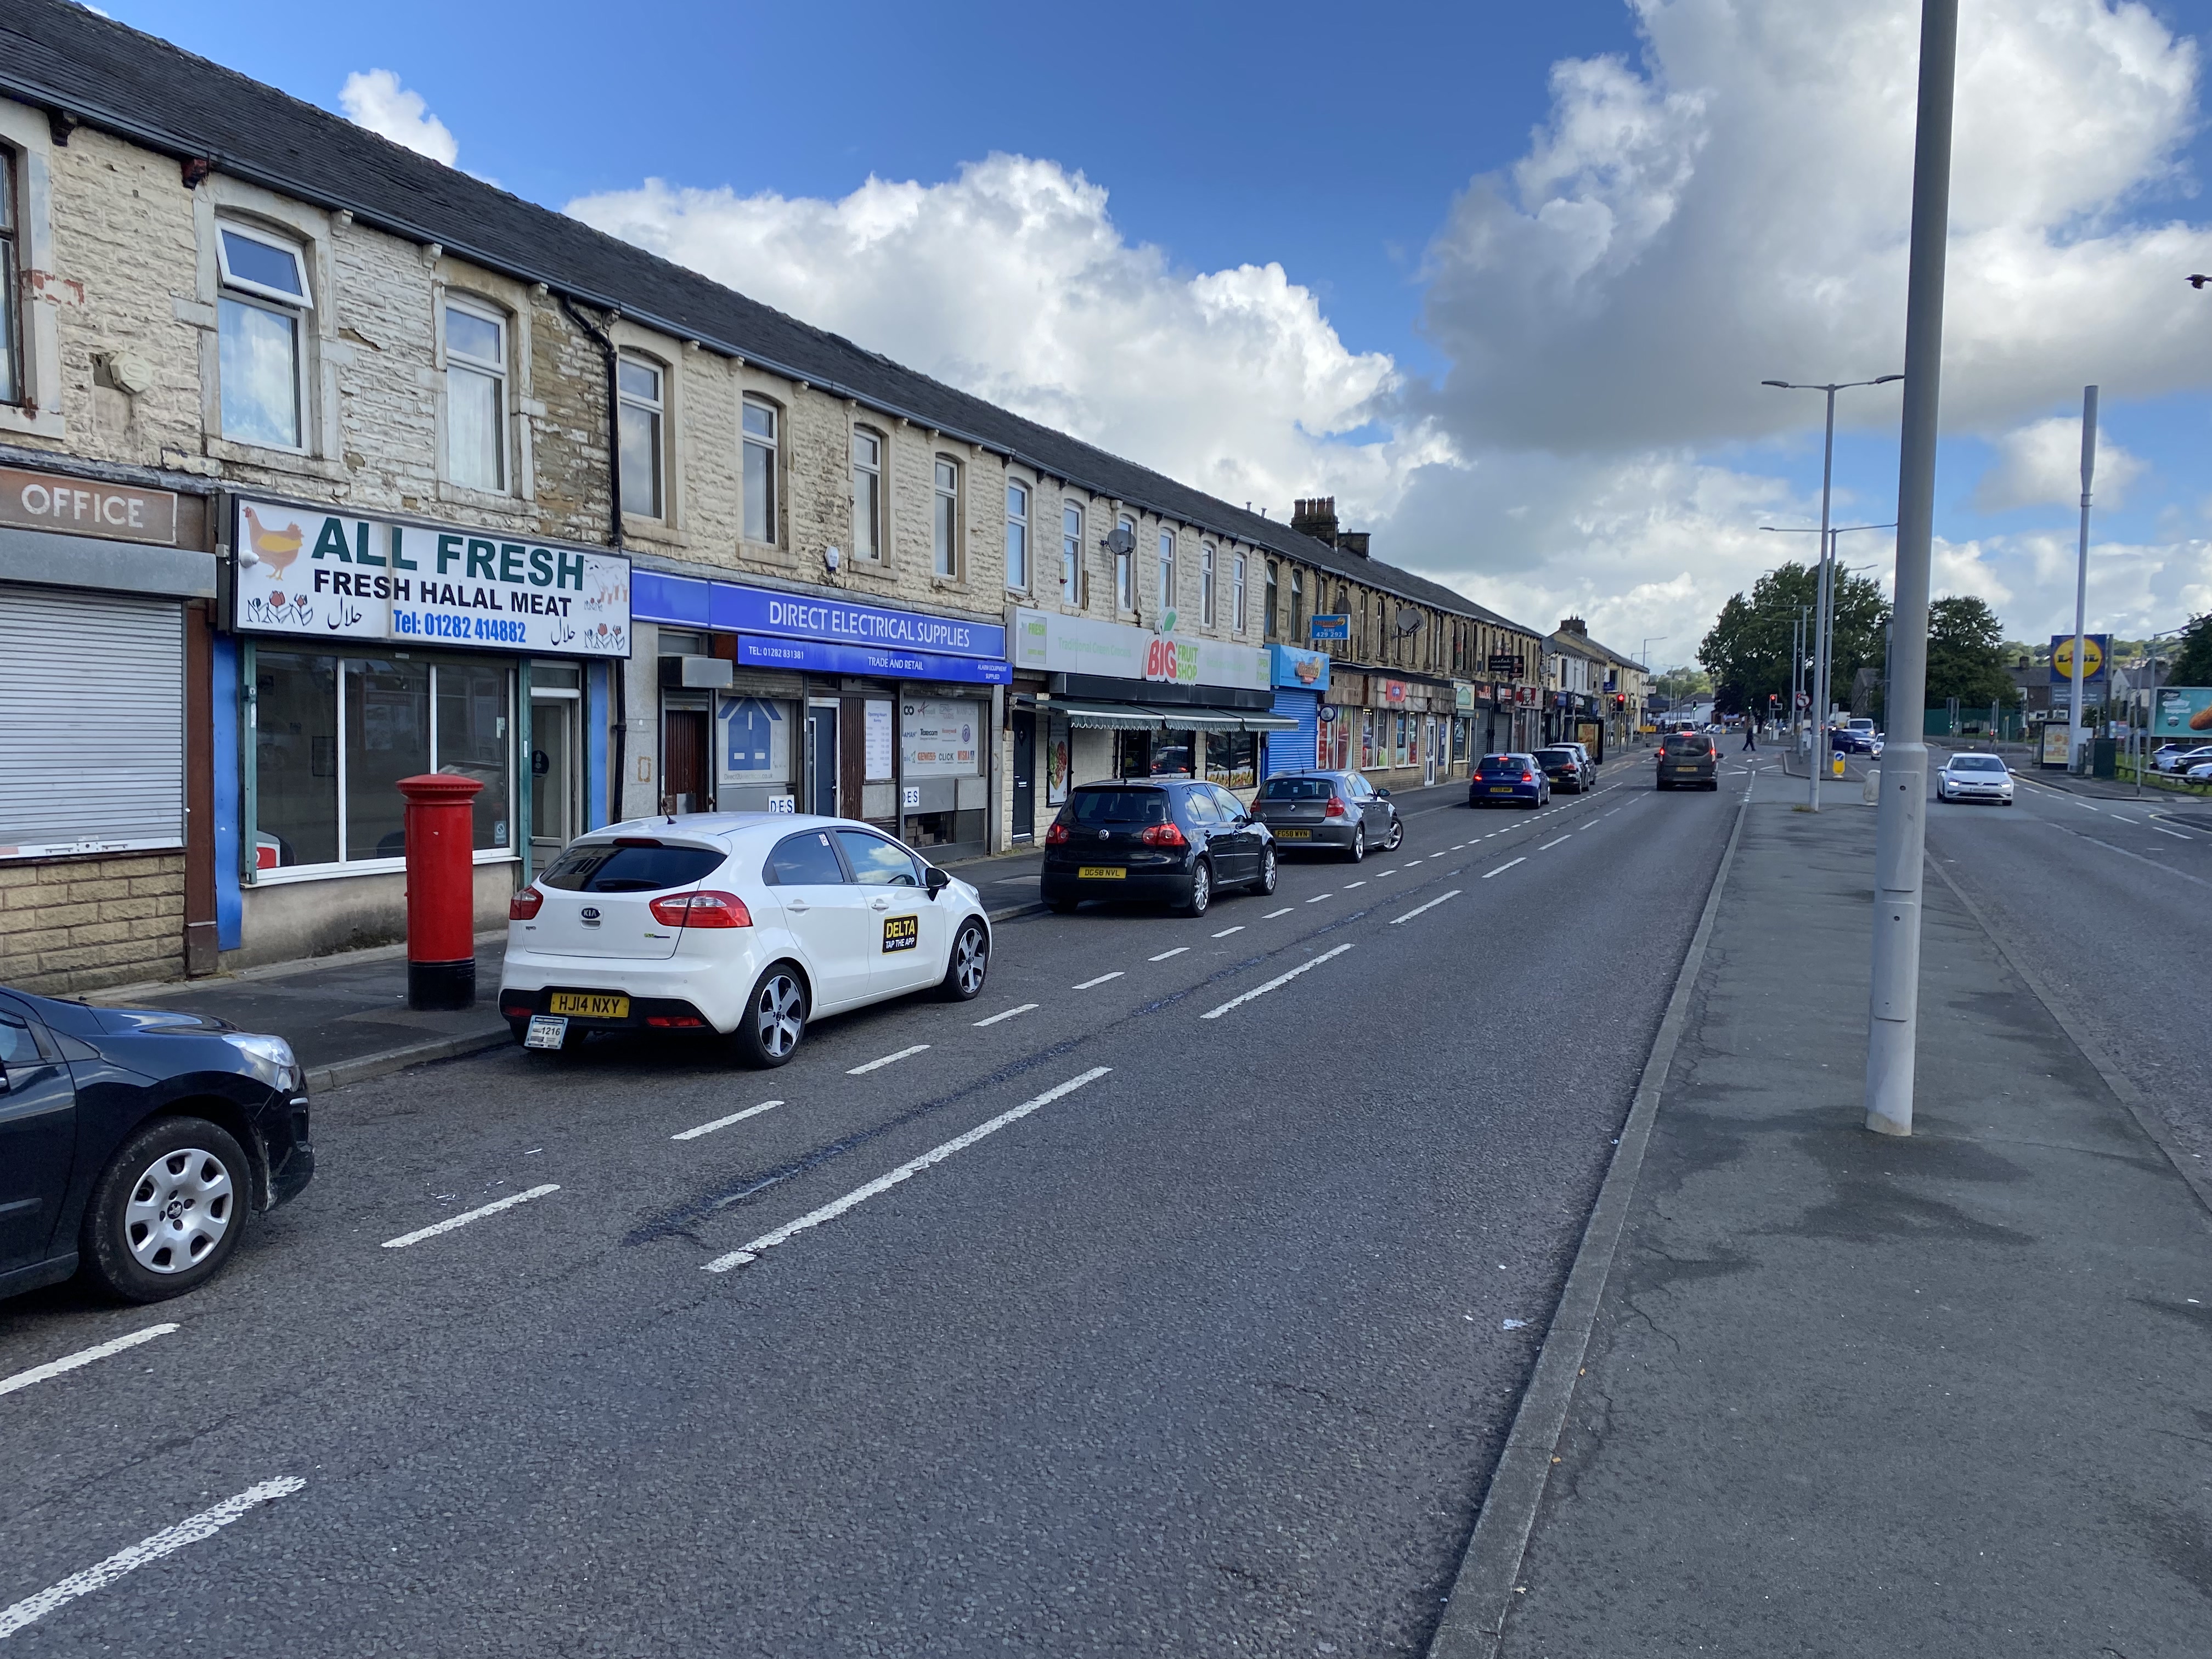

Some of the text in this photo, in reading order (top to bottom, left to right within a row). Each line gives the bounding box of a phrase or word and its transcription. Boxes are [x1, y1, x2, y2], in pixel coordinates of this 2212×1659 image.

[21, 484, 144, 528] OFFICE
[311, 516, 585, 591] ALL FRESH
[314, 569, 572, 617] FRESH HALAL MEAT
[328, 596, 362, 630] حلال
[393, 610, 526, 643] Tel: 01282 414882
[551, 617, 575, 645] حلال
[770, 601, 970, 647] DIRECT ELECTRICAL SUPPLIES
[1029, 623, 1045, 636] FRESH
[748, 646, 804, 659] TEL: 01282 831381
[1058, 637, 1092, 653] Traditional
[1178, 644, 1198, 663] FRUIT
[868, 657, 923, 670] TRADE AND RETAIL
[1148, 640, 1176, 678] BIG
[1178, 663, 1197, 681] SHOP
[886, 919, 915, 939] DELTA
[885, 937, 915, 949] TAP THE APP
[592, 998, 620, 1014] NXY
[542, 1026, 561, 1036] 1216
